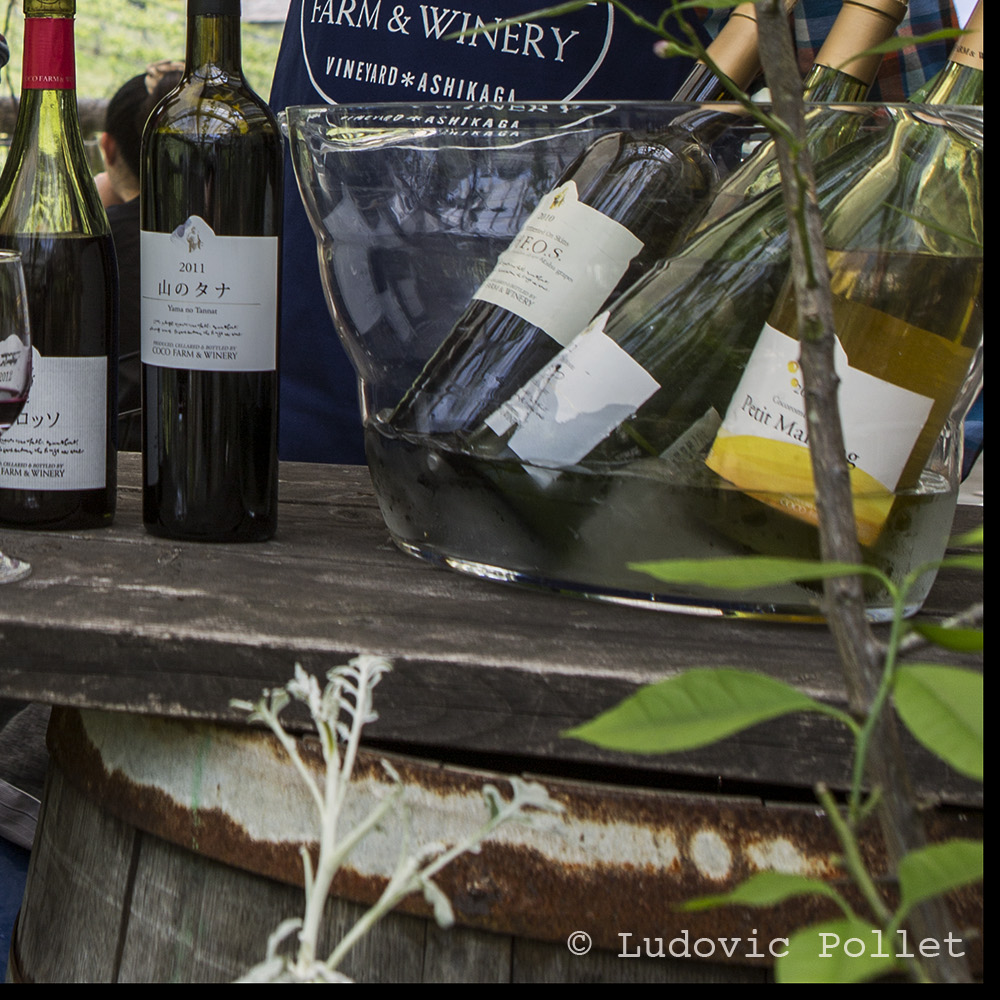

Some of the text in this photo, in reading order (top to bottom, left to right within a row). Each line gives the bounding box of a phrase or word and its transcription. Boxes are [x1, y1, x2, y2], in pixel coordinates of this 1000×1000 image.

[387, 5, 411, 35] &
[419, 4, 579, 63] WINERY
[179, 262, 205, 273] 2011
[168, 304, 184, 313] Yama
[195, 306, 217, 315] Tannat
[152, 346, 171, 355] COCO
[173, 349, 194, 358] FARM
[204, 351, 237, 360] WINERY
[741, 394, 772, 425] Petit
[1, 468, 22, 476] FARM
[31, 469, 65, 478] WINERY
